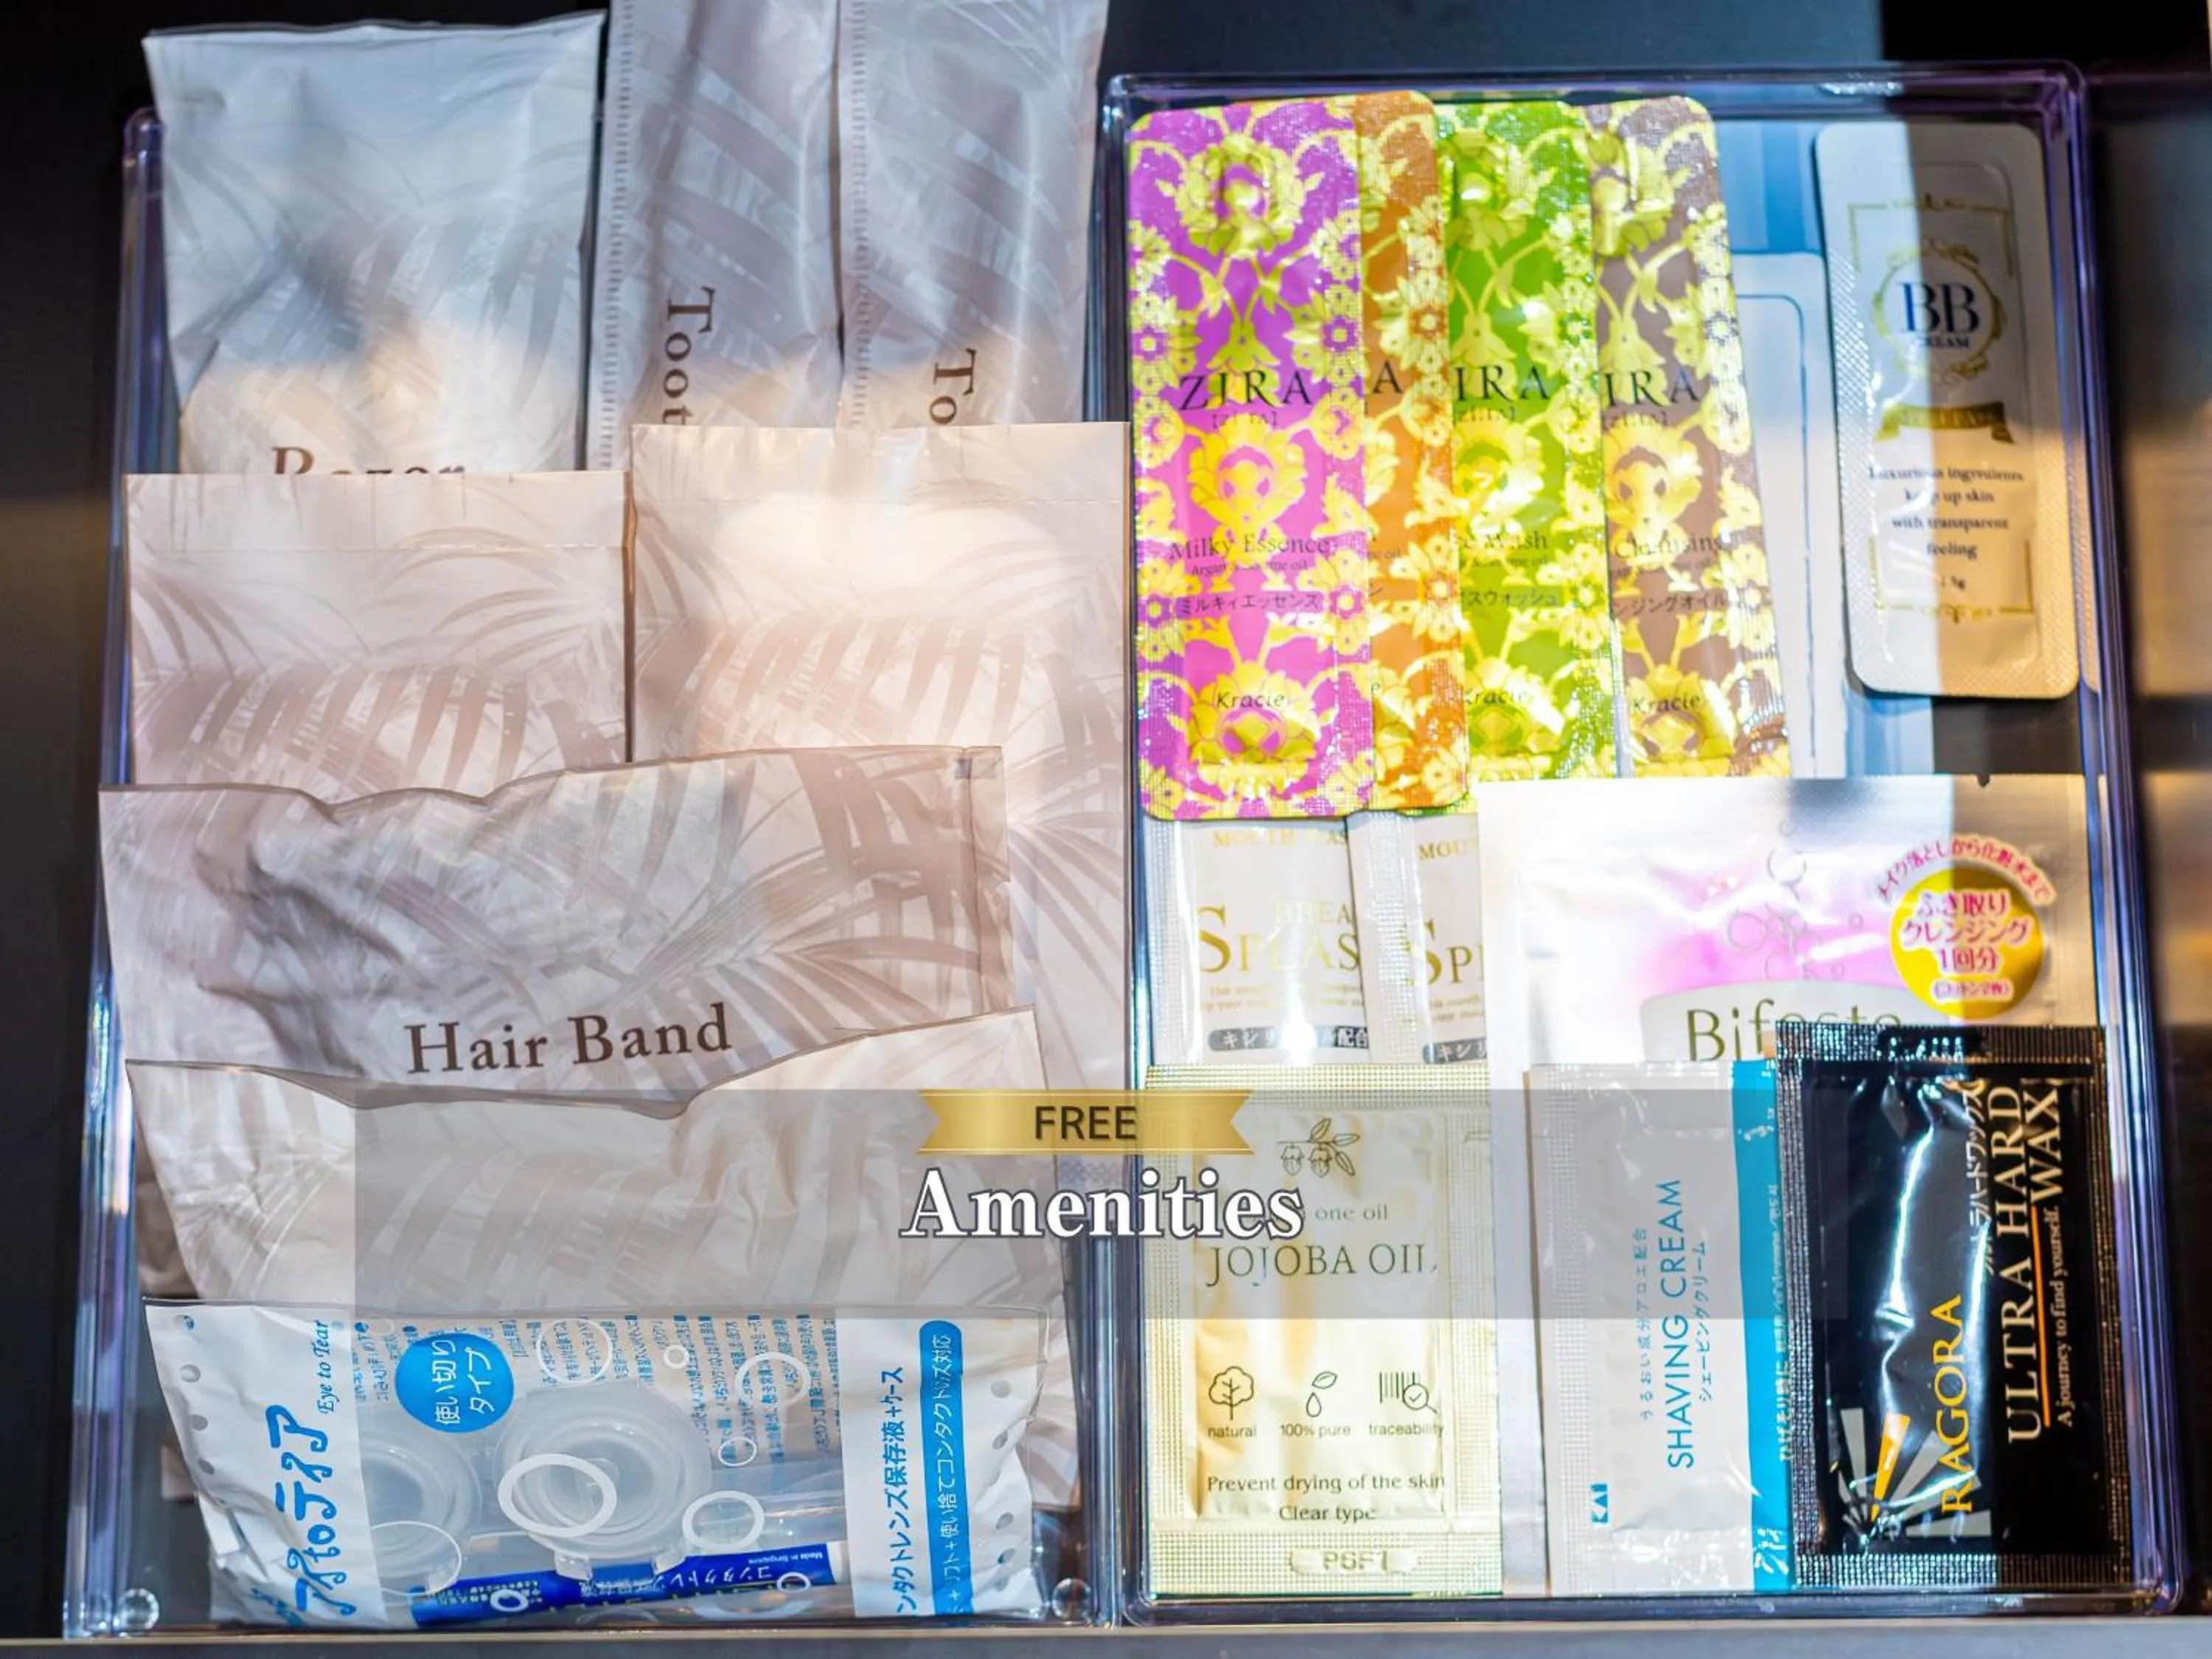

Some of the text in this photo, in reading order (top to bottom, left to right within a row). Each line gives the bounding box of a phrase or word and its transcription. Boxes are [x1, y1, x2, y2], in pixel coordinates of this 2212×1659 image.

[1896, 281, 1980, 334] BB
[929, 348, 977, 425] To
[1180, 369, 1312, 411] ZIRA
[1455, 366, 1549, 402] IRA
[1604, 370, 1700, 407] IRA
[1892, 516, 2009, 533] with transparent
[1169, 532, 1330, 560] Milky Essence
[1927, 541, 1978, 560] feeling
[1461, 589, 1557, 607] スウォッシュ
[1215, 689, 1286, 709] Kracie
[1632, 695, 1701, 713] Kracie
[1903, 919, 2029, 943] クレンジング
[1938, 947, 2000, 972] 1回分
[403, 1001, 733, 1074] Hair Band
[2023, 1086, 2065, 1206] WAX
[1315, 1203, 1388, 1221] one oil
[1206, 1244, 1357, 1287] JOJOBA
[1987, 1085, 2043, 1445] ULTRA HARD
[1632, 1227, 1653, 1422] うるおい成分アロエ配合
[1656, 1179, 1695, 1470] SHAVING CREAM
[1691, 1242, 1712, 1403] シェービングクリーム
[2045, 1206, 2076, 1427] A journey to find yourself.
[313, 1320, 336, 1414] Eye to Tear
[432, 1338, 461, 1425] 使い切り
[465, 1346, 495, 1415] タイプ
[1929, 1294, 1973, 1514] RAGORA
[1208, 1425, 1258, 1439] natural
[1280, 1424, 1352, 1440] 100% pure
[1368, 1422, 1444, 1439] traceability
[1208, 1474, 1445, 1495] Prevent drying of the skin
[1279, 1504, 1377, 1525] Clear type
[1590, 1484, 1608, 1524] KAI
[748, 1551, 824, 1565] Made in Singapore
